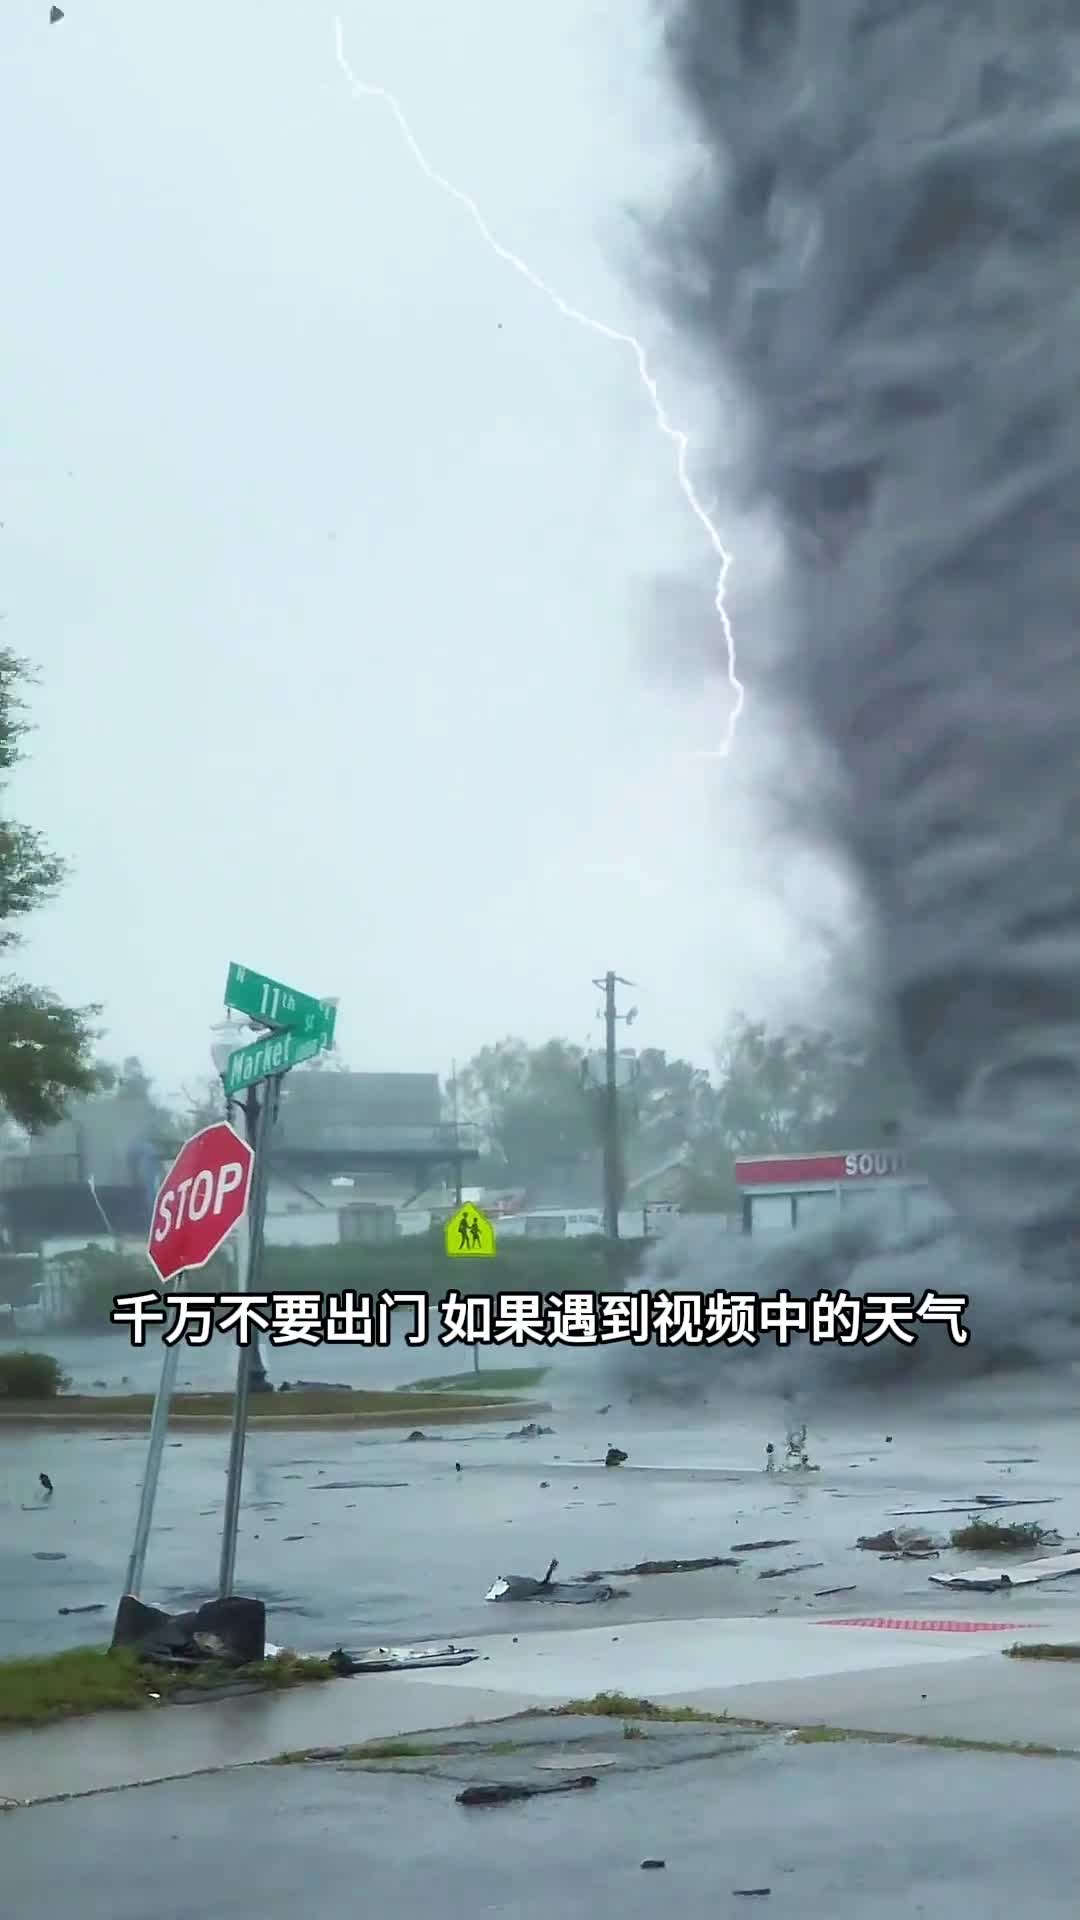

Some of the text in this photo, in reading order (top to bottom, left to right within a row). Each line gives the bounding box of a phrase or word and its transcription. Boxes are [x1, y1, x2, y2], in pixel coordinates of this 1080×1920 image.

[260, 983, 296, 1020] 11th
[230, 1032, 293, 1087] Market
[154, 1162, 243, 1243] STOP
